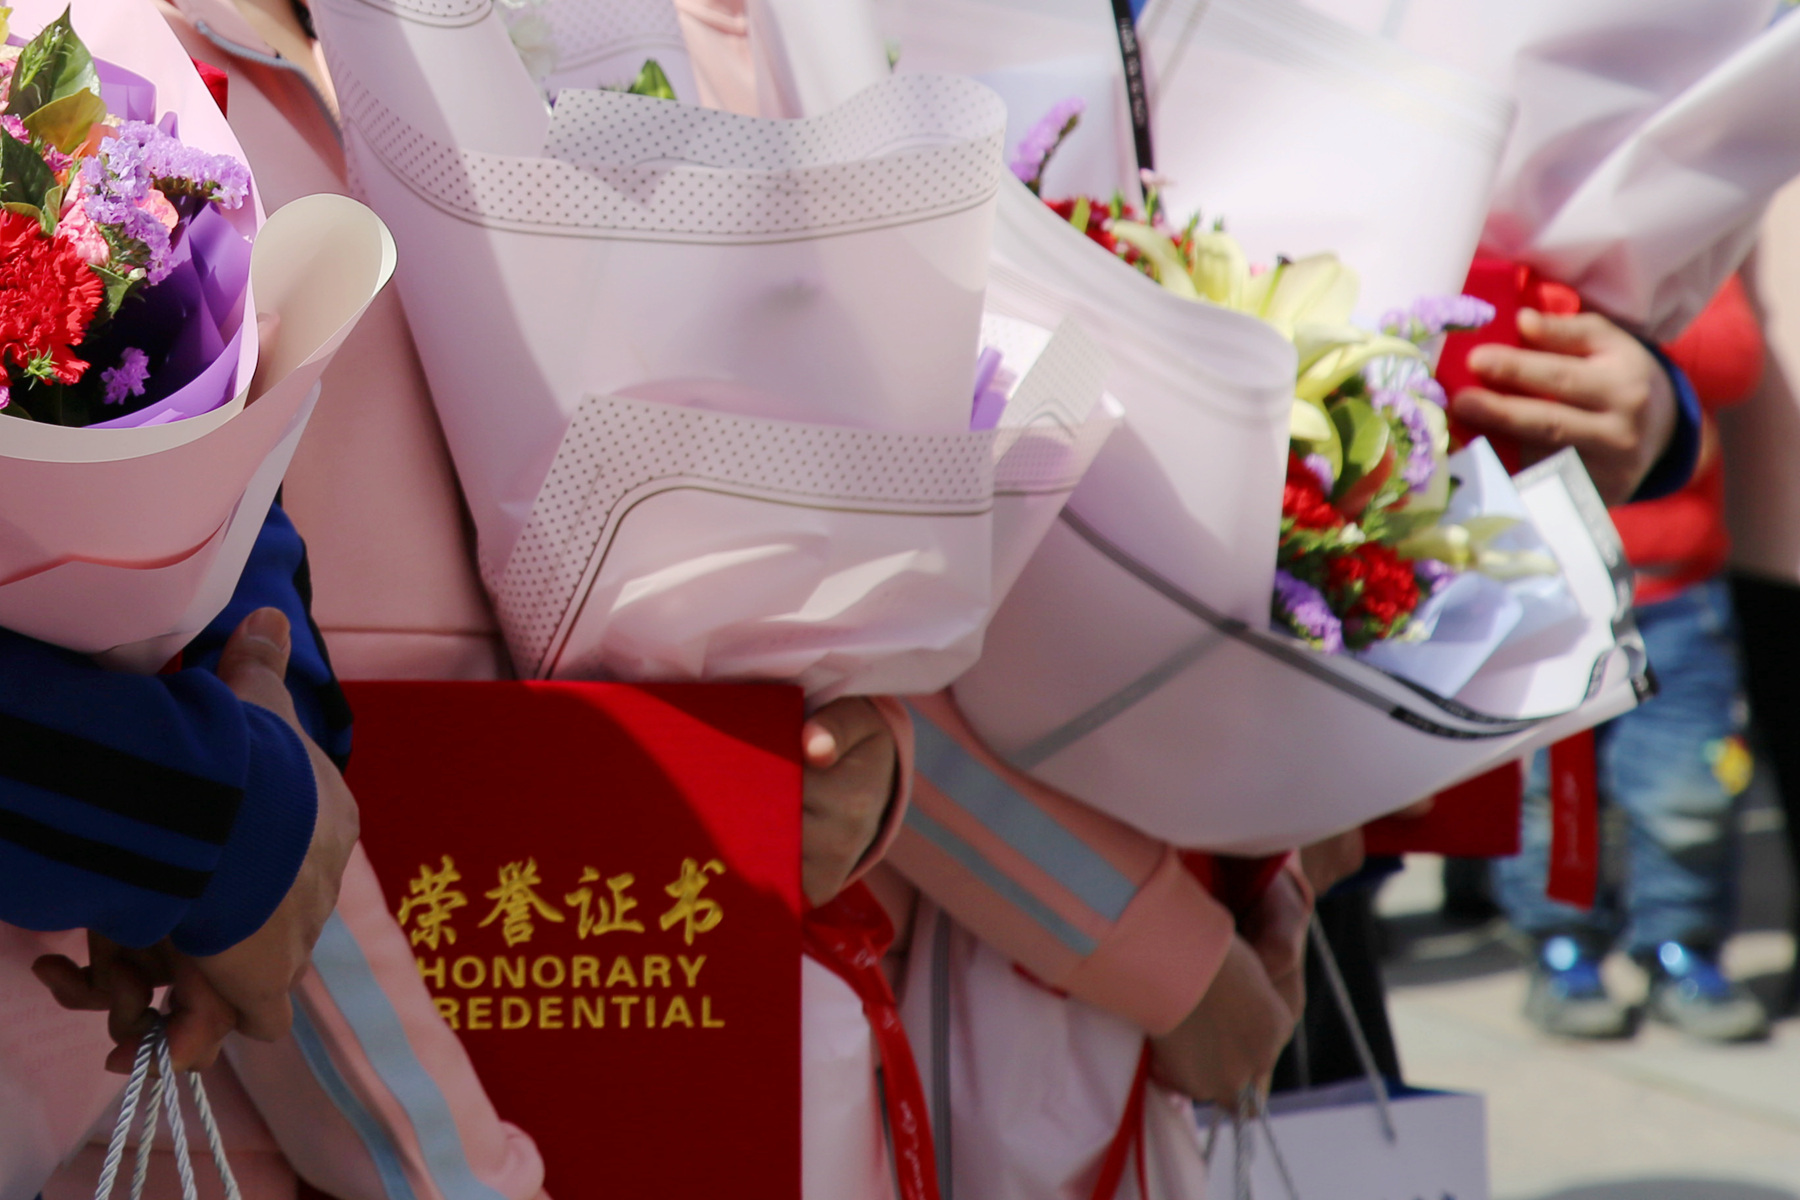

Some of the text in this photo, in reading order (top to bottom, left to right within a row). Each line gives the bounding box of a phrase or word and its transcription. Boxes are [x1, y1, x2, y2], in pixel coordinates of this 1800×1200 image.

[397, 855, 726, 950] 荣誉证书
[416, 954, 707, 989] HONORARY
[433, 996, 726, 1030] REDENTIAL
